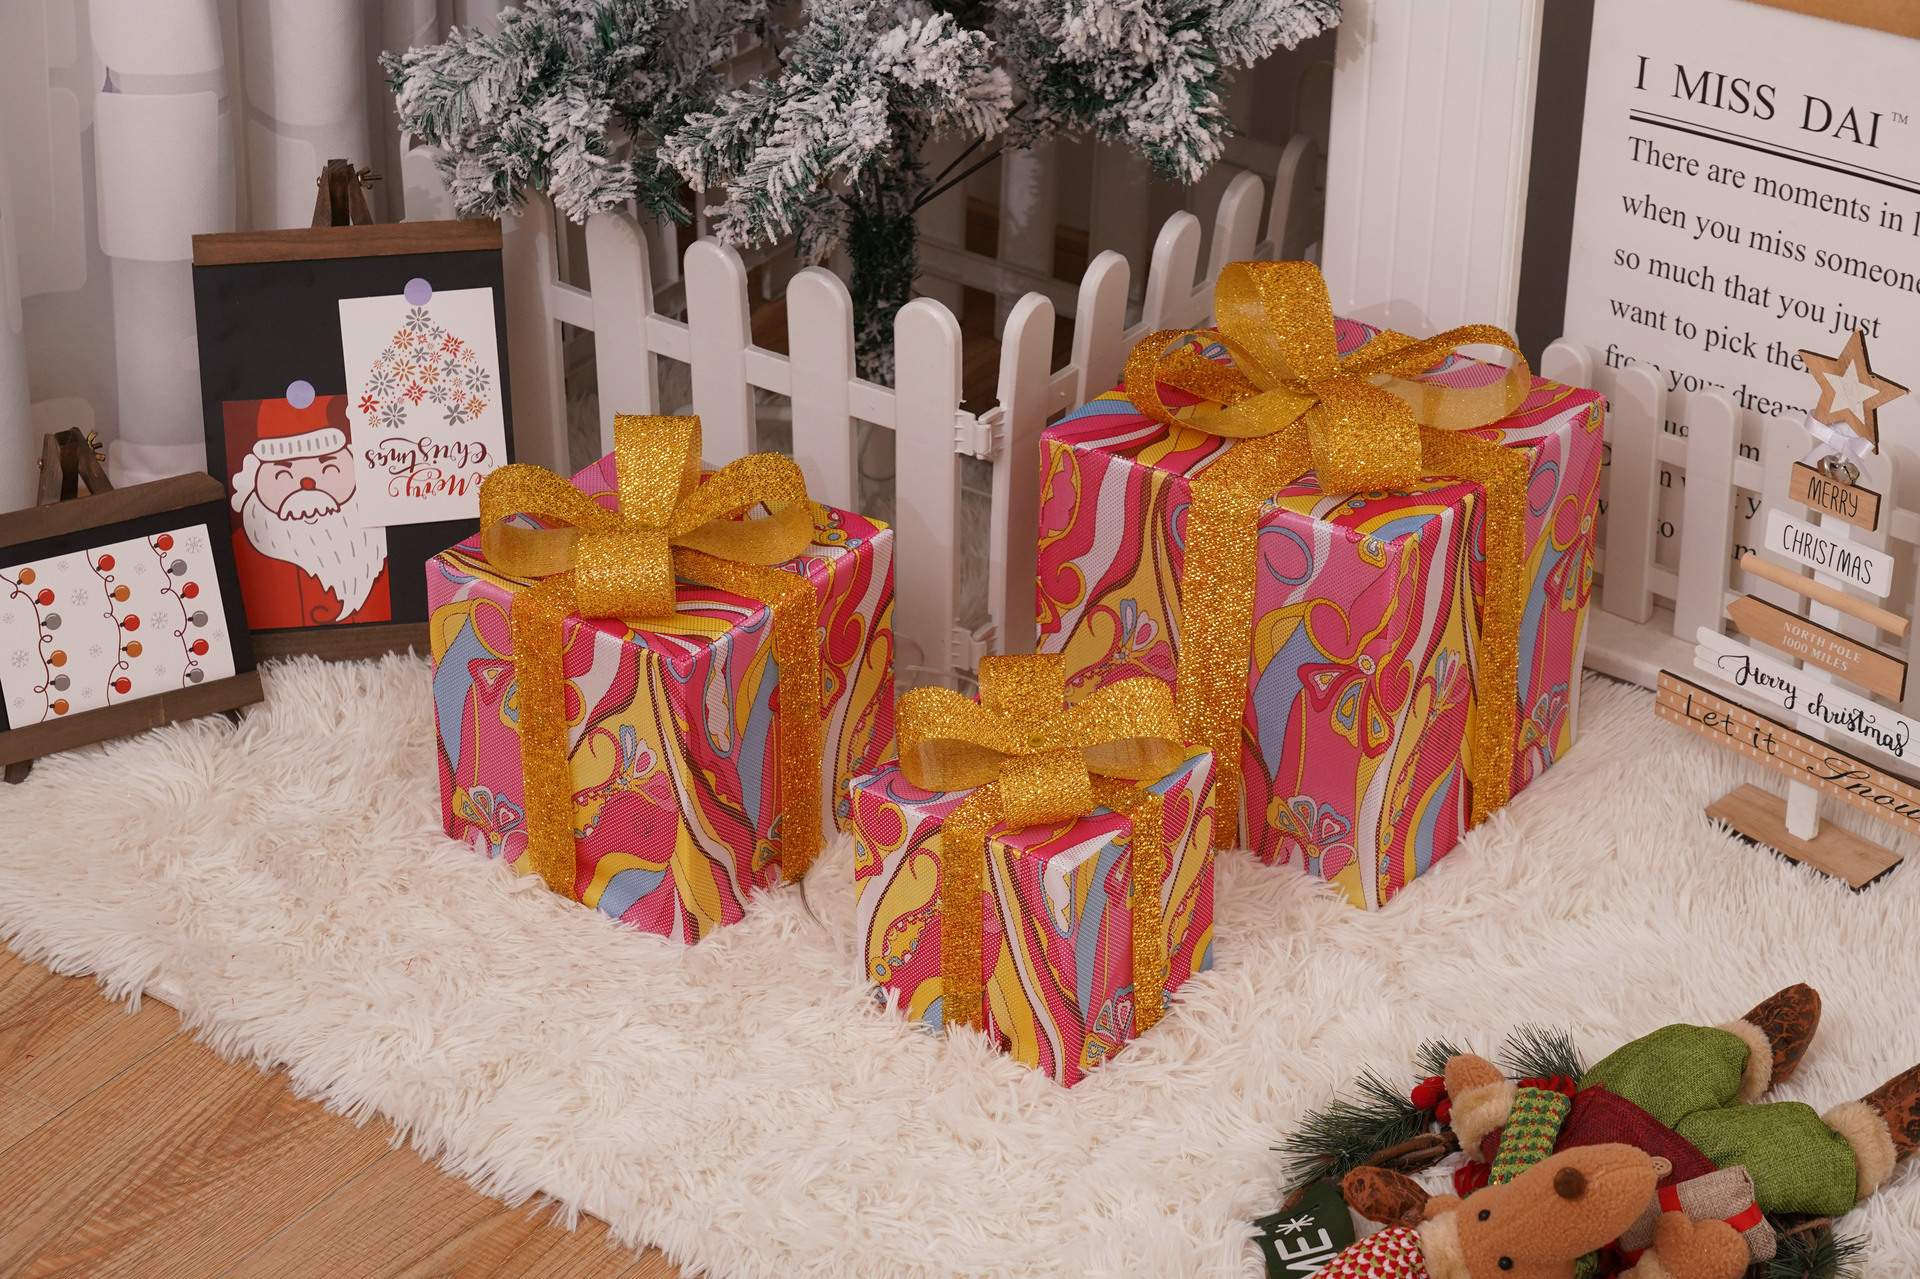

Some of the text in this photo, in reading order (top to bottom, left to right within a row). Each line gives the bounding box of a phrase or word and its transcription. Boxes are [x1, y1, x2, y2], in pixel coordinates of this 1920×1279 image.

[1634, 54, 1650, 90] I
[1671, 63, 1776, 121] MISS
[1799, 94, 1884, 149] DAI
[1628, 136, 1699, 176] There
[1707, 162, 1746, 189] are
[1753, 176, 1870, 223] moments
[1879, 202, 1903, 232] in
[1622, 194, 1686, 229] when
[1693, 214, 1741, 244] you
[1748, 229, 1806, 262] miss
[1613, 248, 1881, 339] so much that you just
[1609, 299, 1811, 374] want to pick the
[365, 437, 494, 475] Christmas
[388, 468, 488, 499] Merry
[1807, 476, 1858, 518] MERRY
[1783, 524, 1873, 585] CHRISTMAS
[1782, 635, 1849, 671] 1000 MILES
[1783, 622, 1862, 663] NORTH POLE
[1685, 694, 1733, 737] Let
[1752, 727, 1776, 756] it
